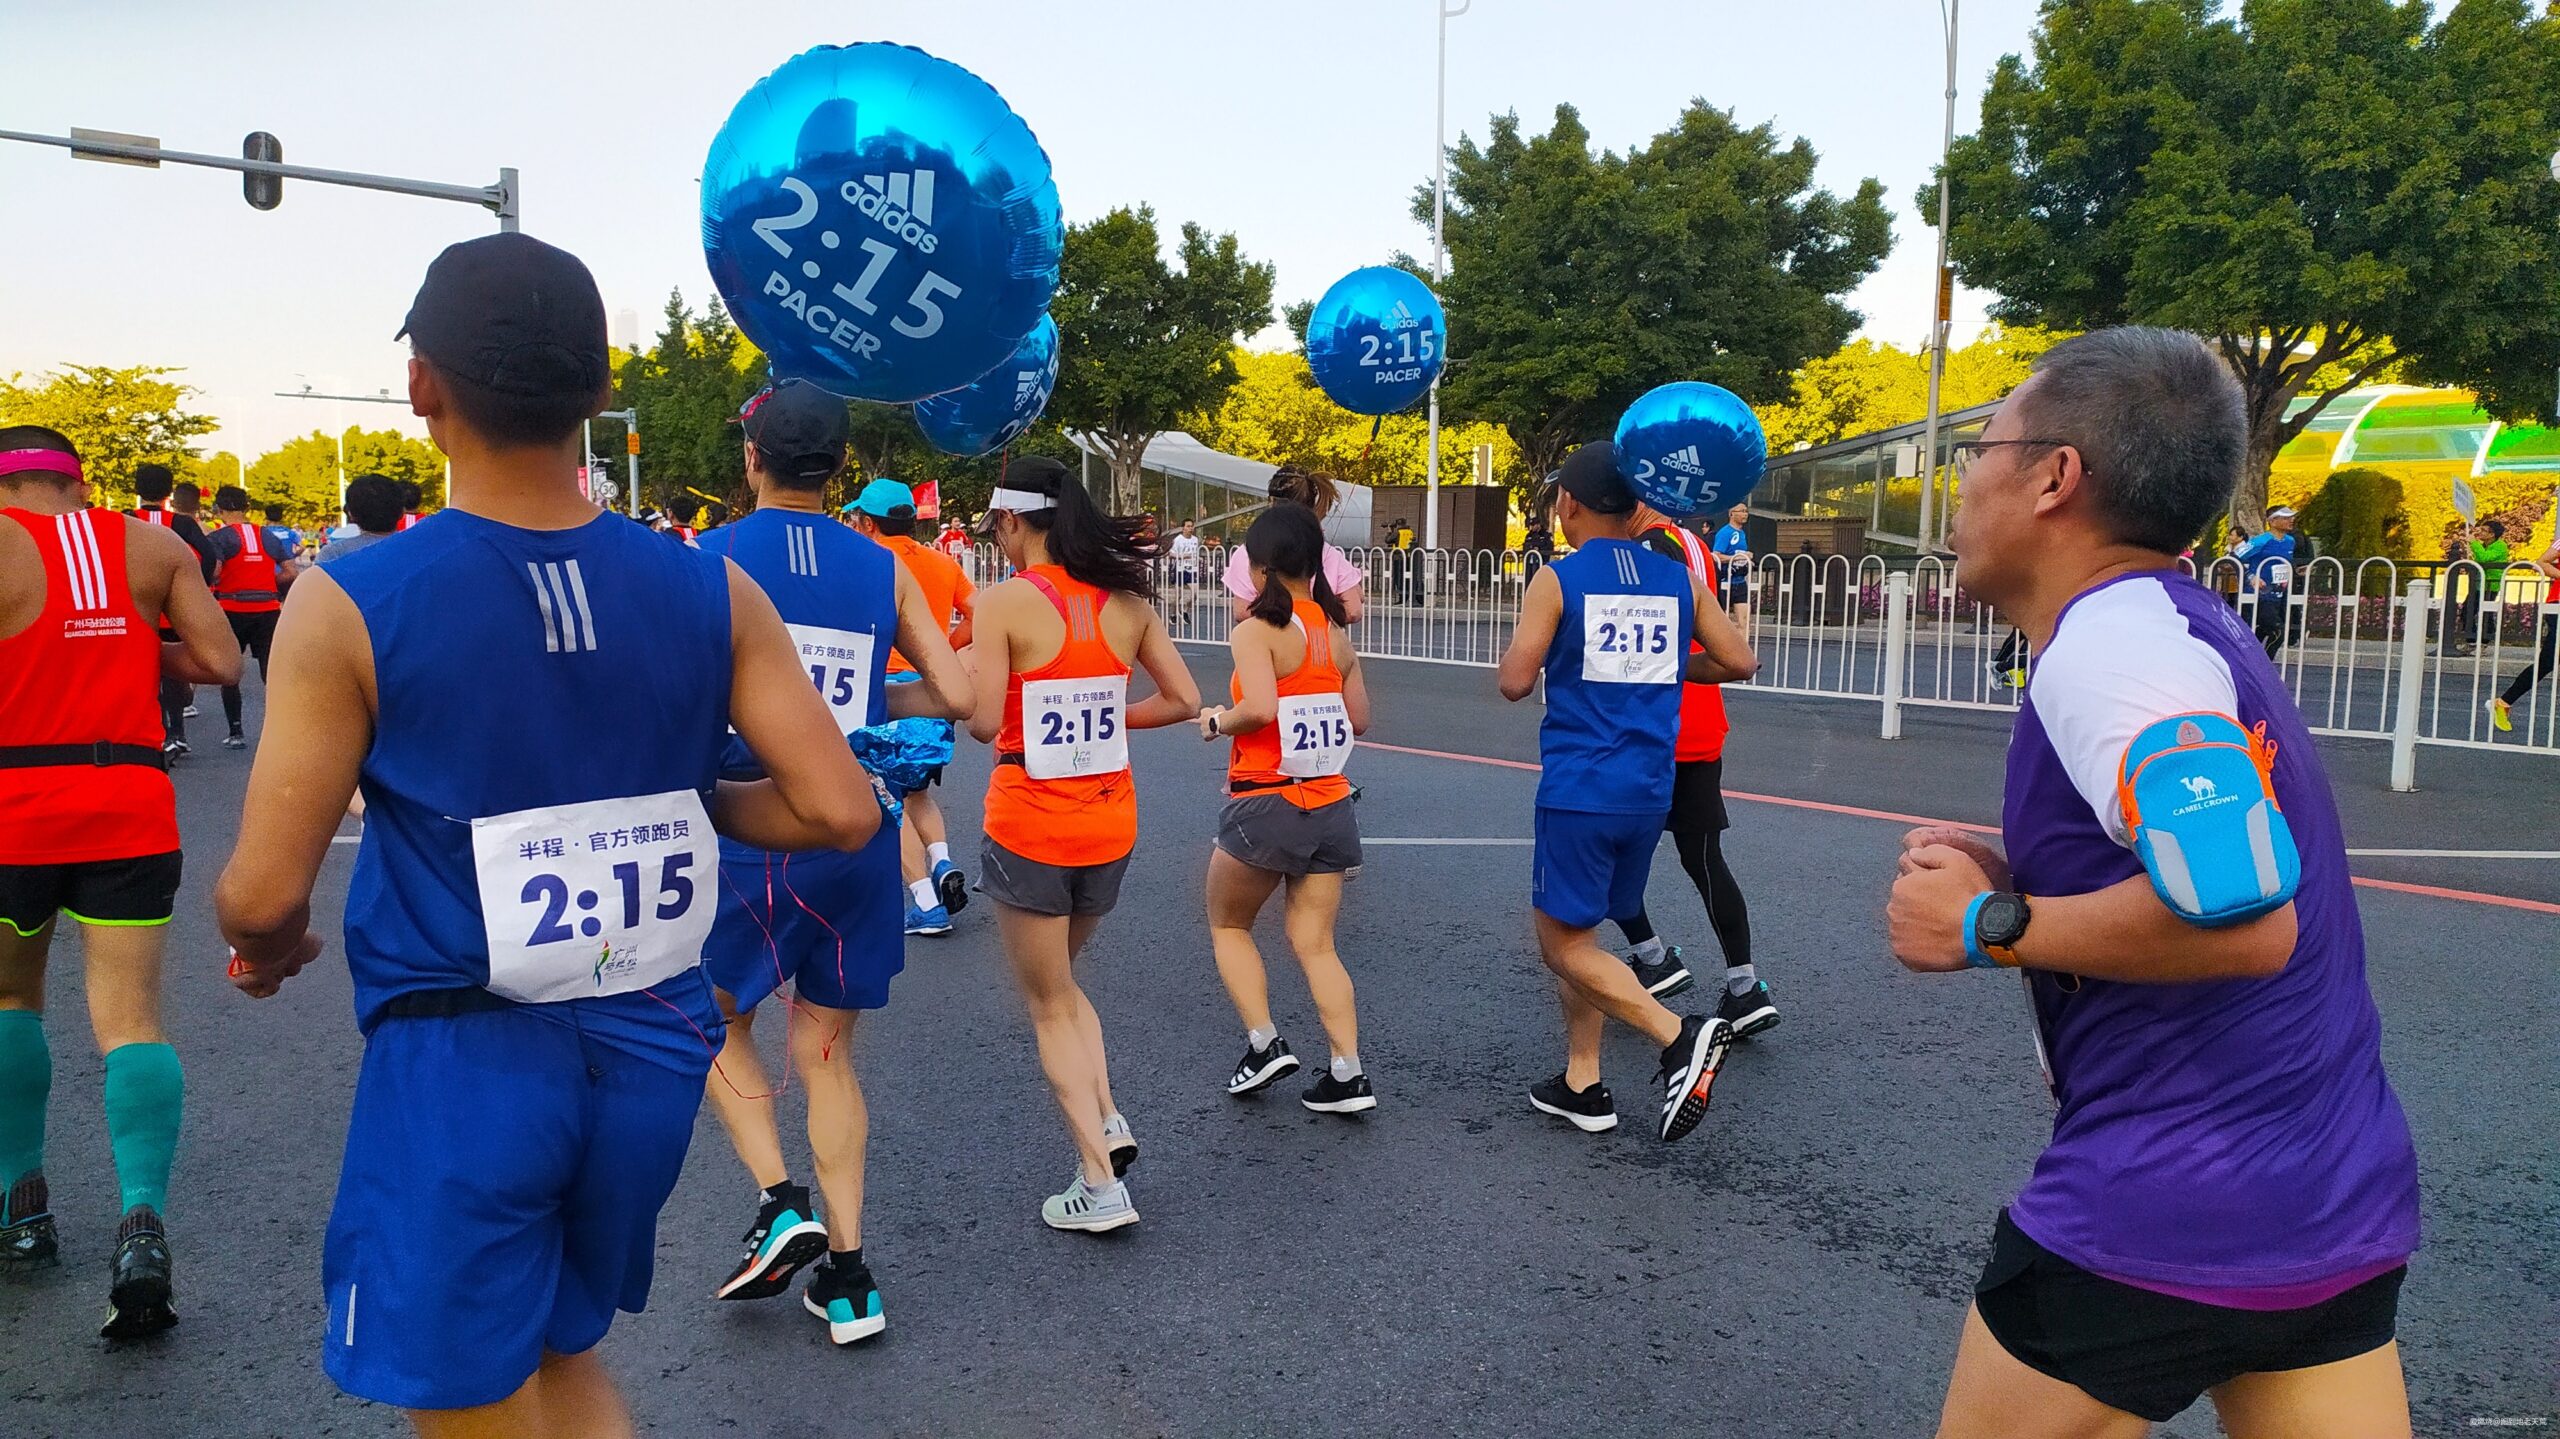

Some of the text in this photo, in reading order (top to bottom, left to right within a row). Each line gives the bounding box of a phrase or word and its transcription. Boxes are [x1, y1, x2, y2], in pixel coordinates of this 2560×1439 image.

[840, 180, 938, 254] adidas
[751, 176, 963, 339] 2:15
[763, 270, 882, 361] PACER
[1359, 329, 1435, 367] 2:15
[1375, 366, 1422, 384] PACER
[1633, 458, 1721, 503] 2:15
[1661, 456, 1705, 476] adidas
[603, 485, 616, 495] 30
[1645, 491, 1697, 513] PACER
[1599, 622, 1668, 654] 2:15
[810, 664, 856, 707] 15
[1040, 706, 1115, 746] 2:15
[1292, 718, 1347, 752] 2:15
[2172, 794, 2239, 816] CAMEL CROWN
[520, 851, 694, 948] 2:15
